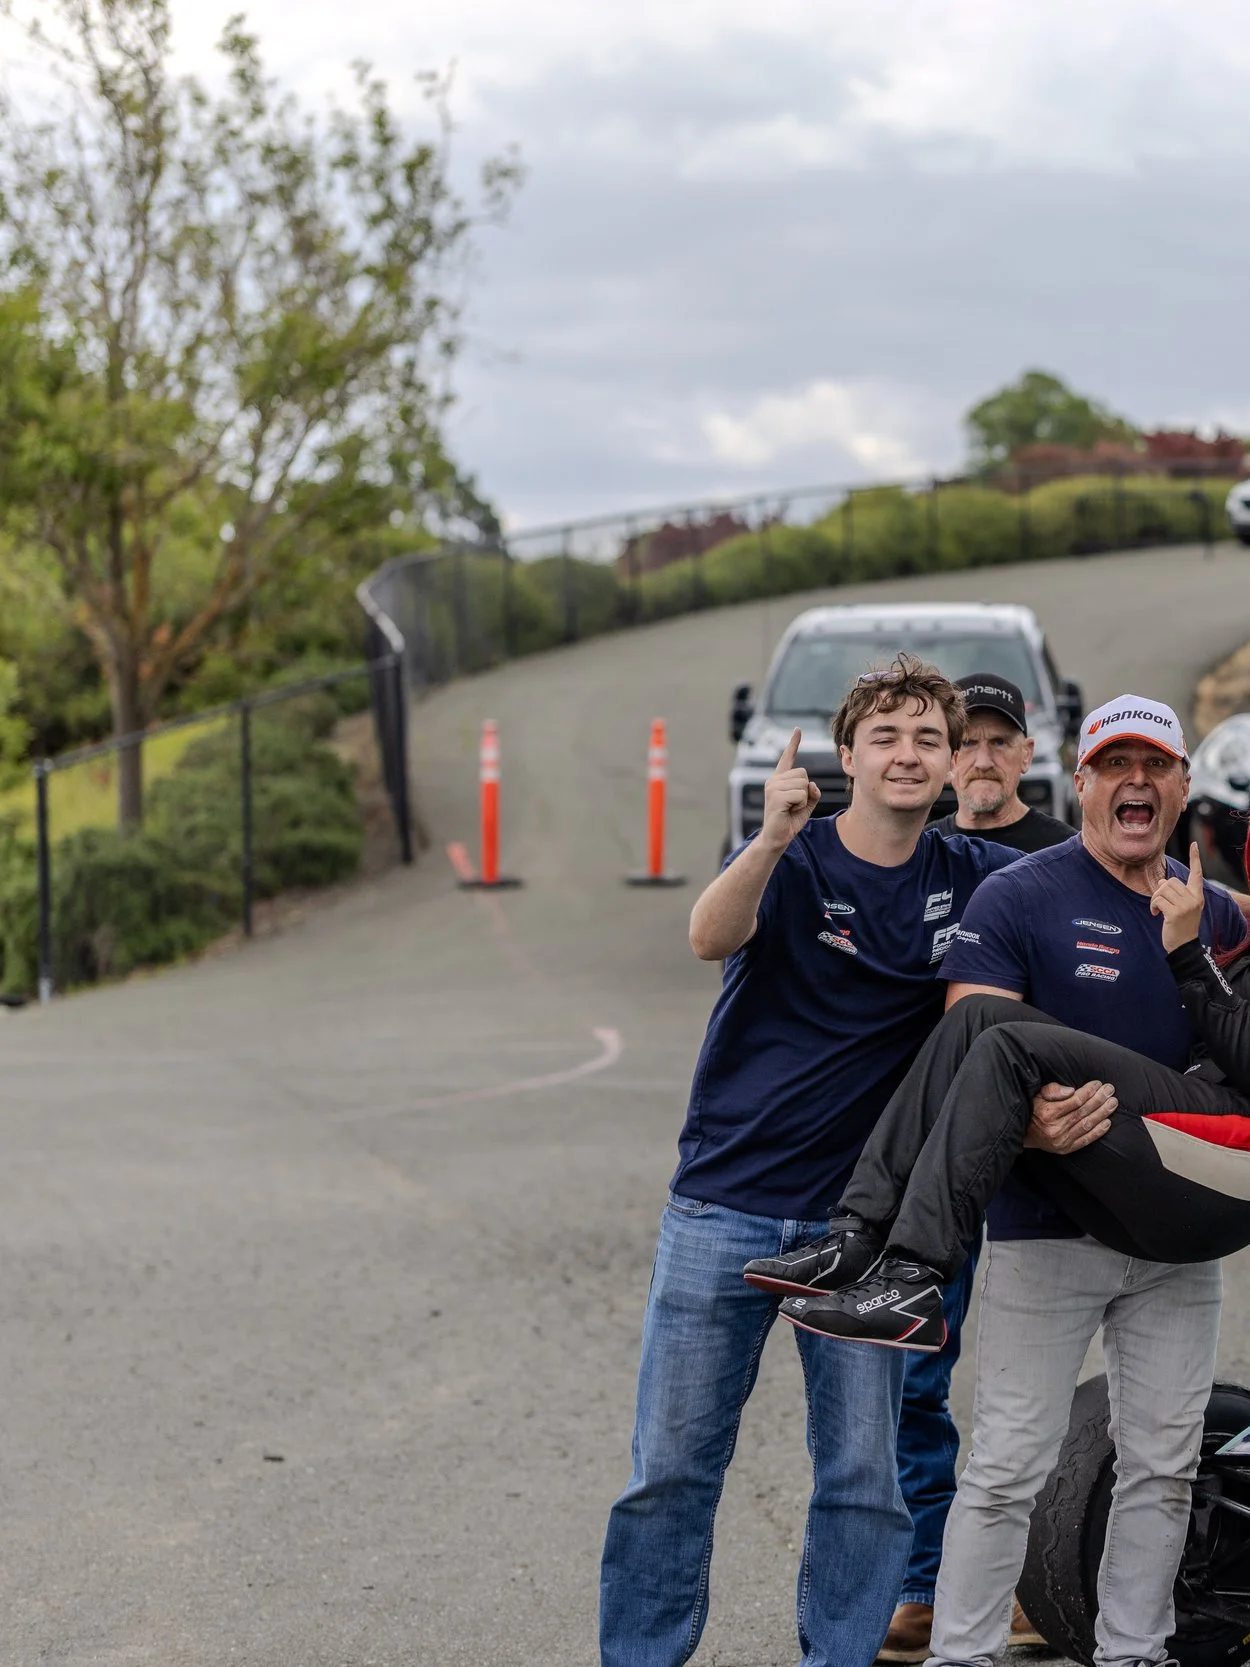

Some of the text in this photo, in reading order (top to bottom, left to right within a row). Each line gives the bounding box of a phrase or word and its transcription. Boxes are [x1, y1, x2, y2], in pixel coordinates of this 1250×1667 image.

[960, 685, 1014, 703] arhartt
[823, 902, 851, 911] NSEN
[1075, 920, 1117, 932] JENSEN
[1090, 966, 1117, 975] SCCA
[856, 1289, 900, 1312] sparco
